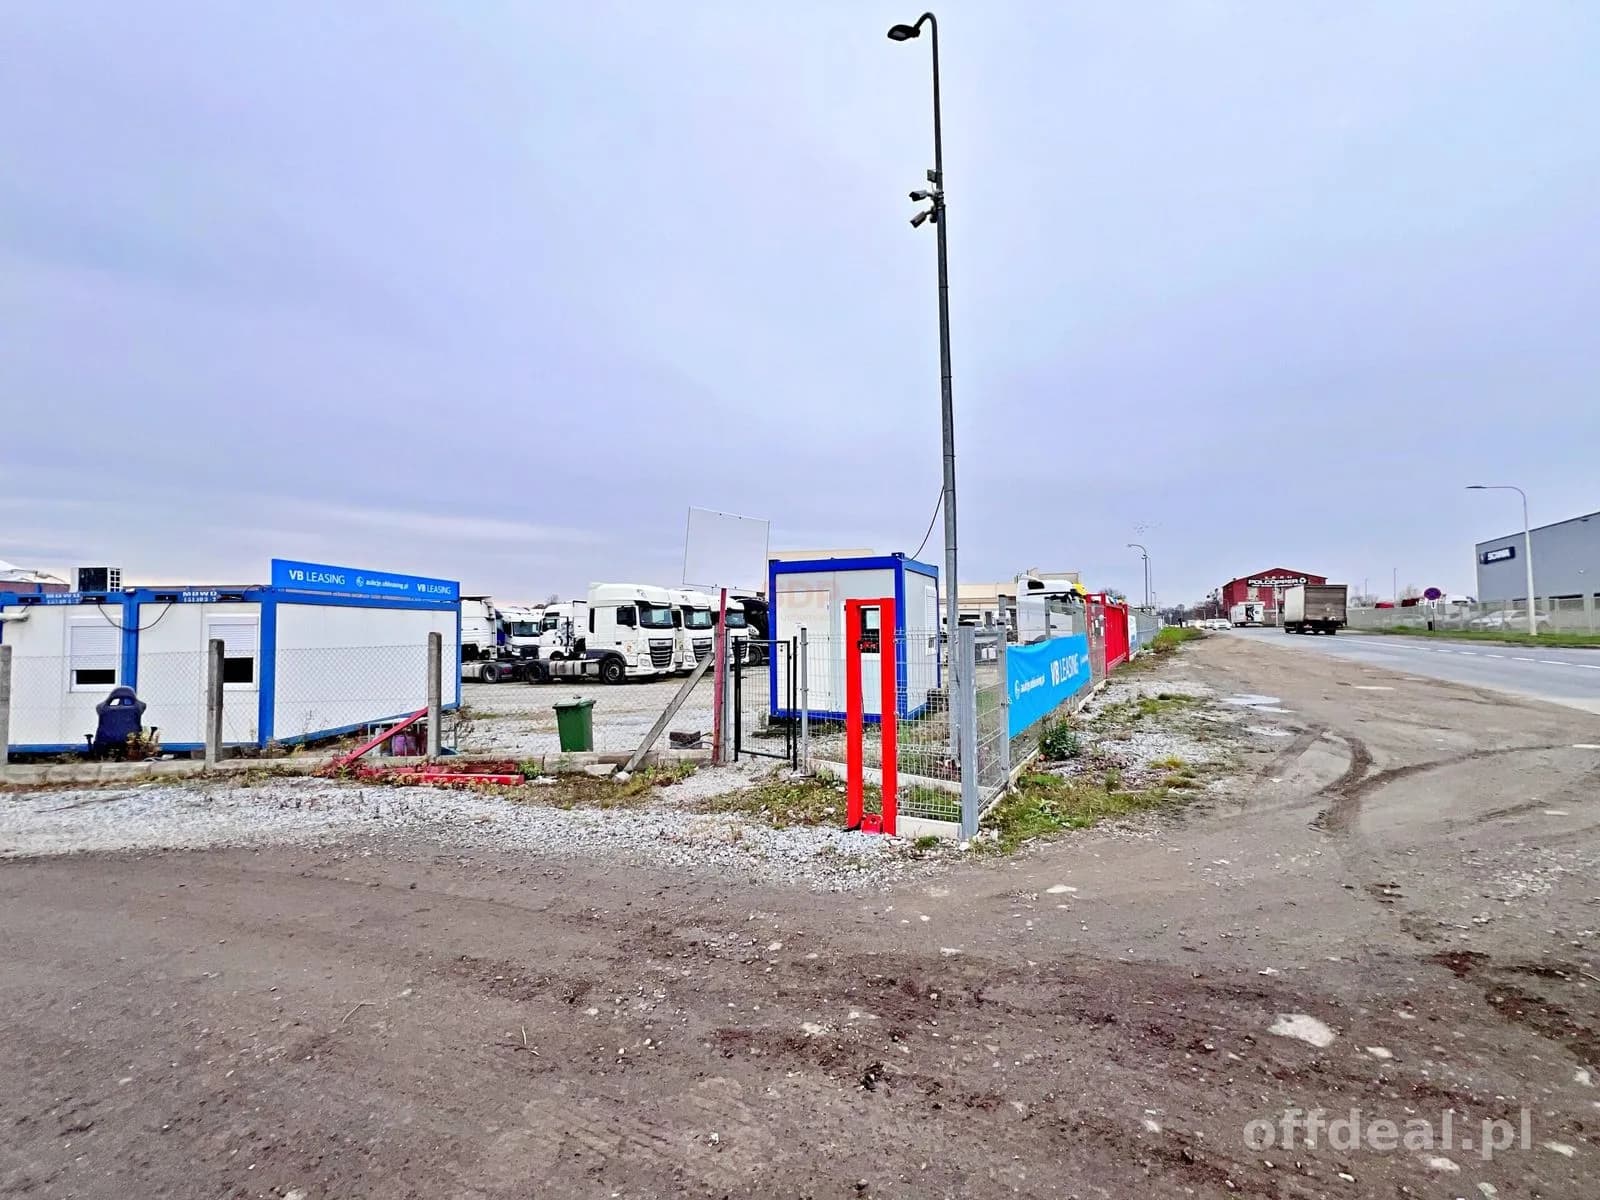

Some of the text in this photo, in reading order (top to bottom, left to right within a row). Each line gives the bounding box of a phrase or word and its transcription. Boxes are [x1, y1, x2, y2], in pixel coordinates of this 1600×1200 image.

[289, 569, 345, 586] VB LEASING
[417, 583, 451, 595] VB LEASING
[1050, 660, 1060, 687] VB
[1060, 653, 1079, 683] LEASING
